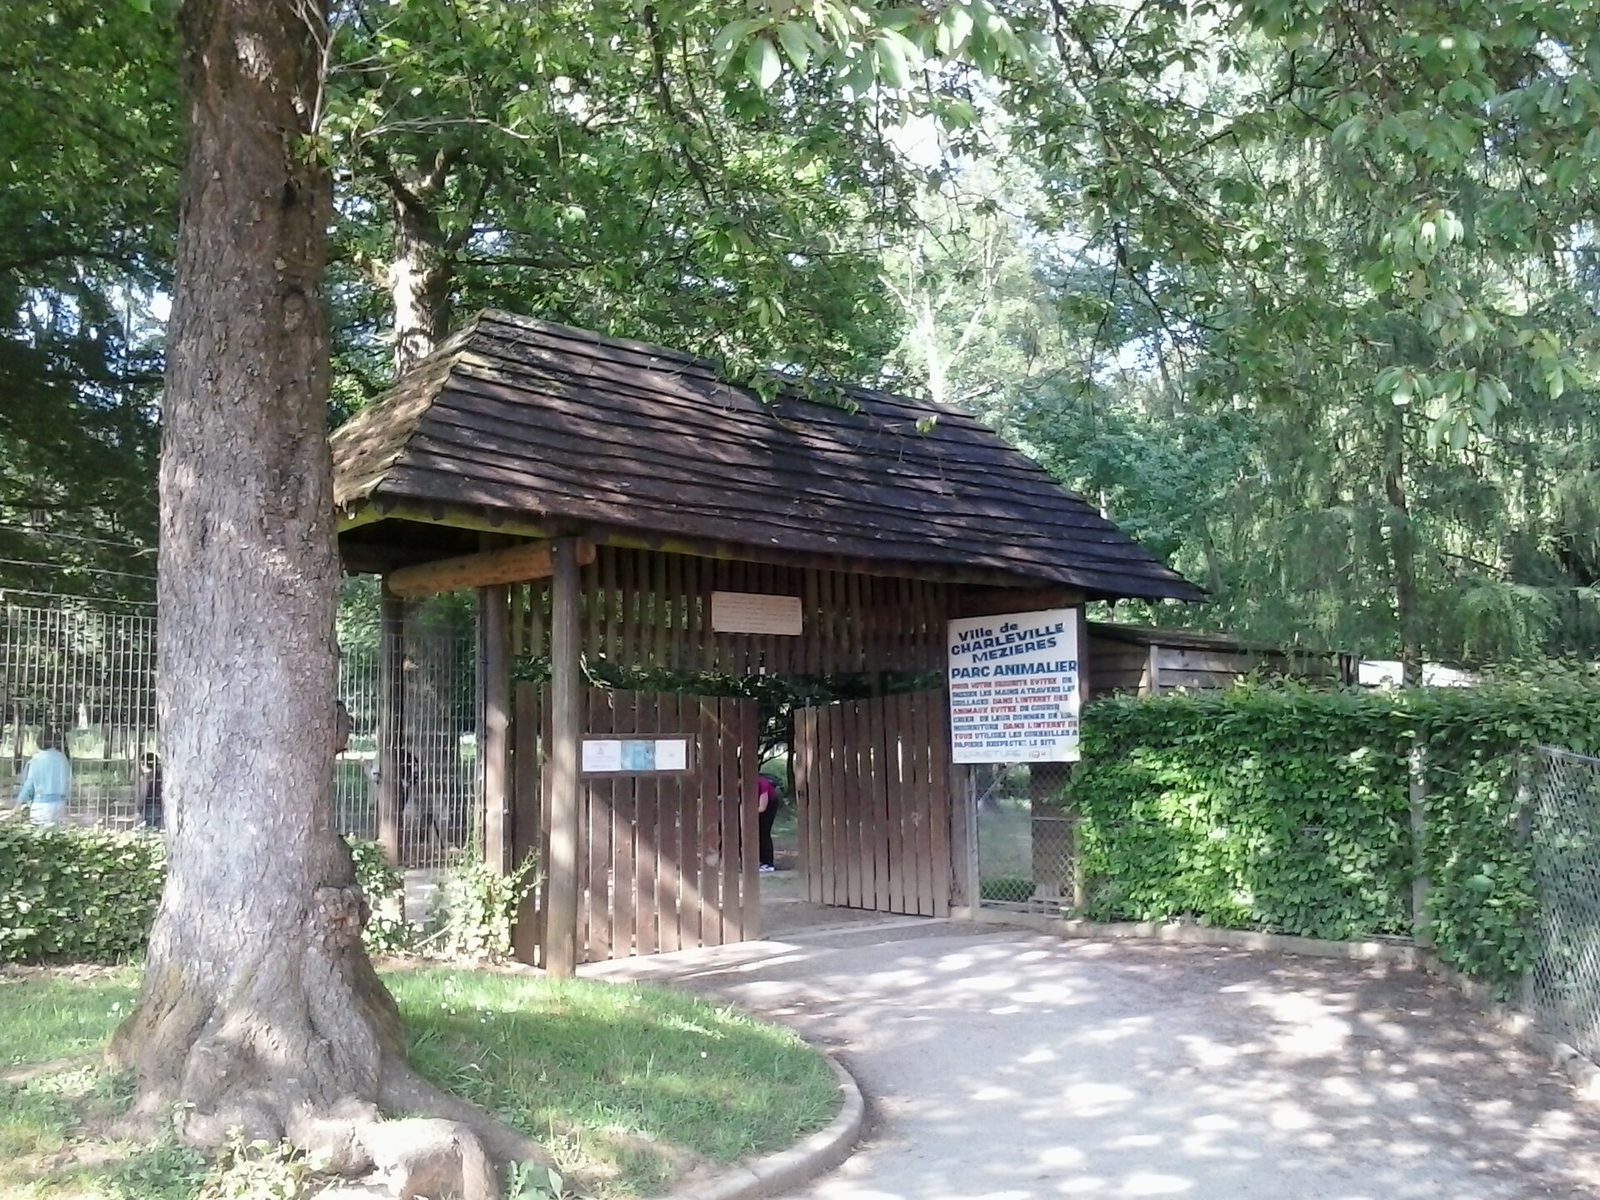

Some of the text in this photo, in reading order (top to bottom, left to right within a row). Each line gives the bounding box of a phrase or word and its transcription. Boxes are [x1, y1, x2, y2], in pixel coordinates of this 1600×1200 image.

[951, 623, 1064, 655] CHARLEVILLE
[958, 622, 1018, 641] Ville de
[972, 638, 1056, 662] MEZIERES
[951, 661, 1077, 678] PARC ANIMALIER
